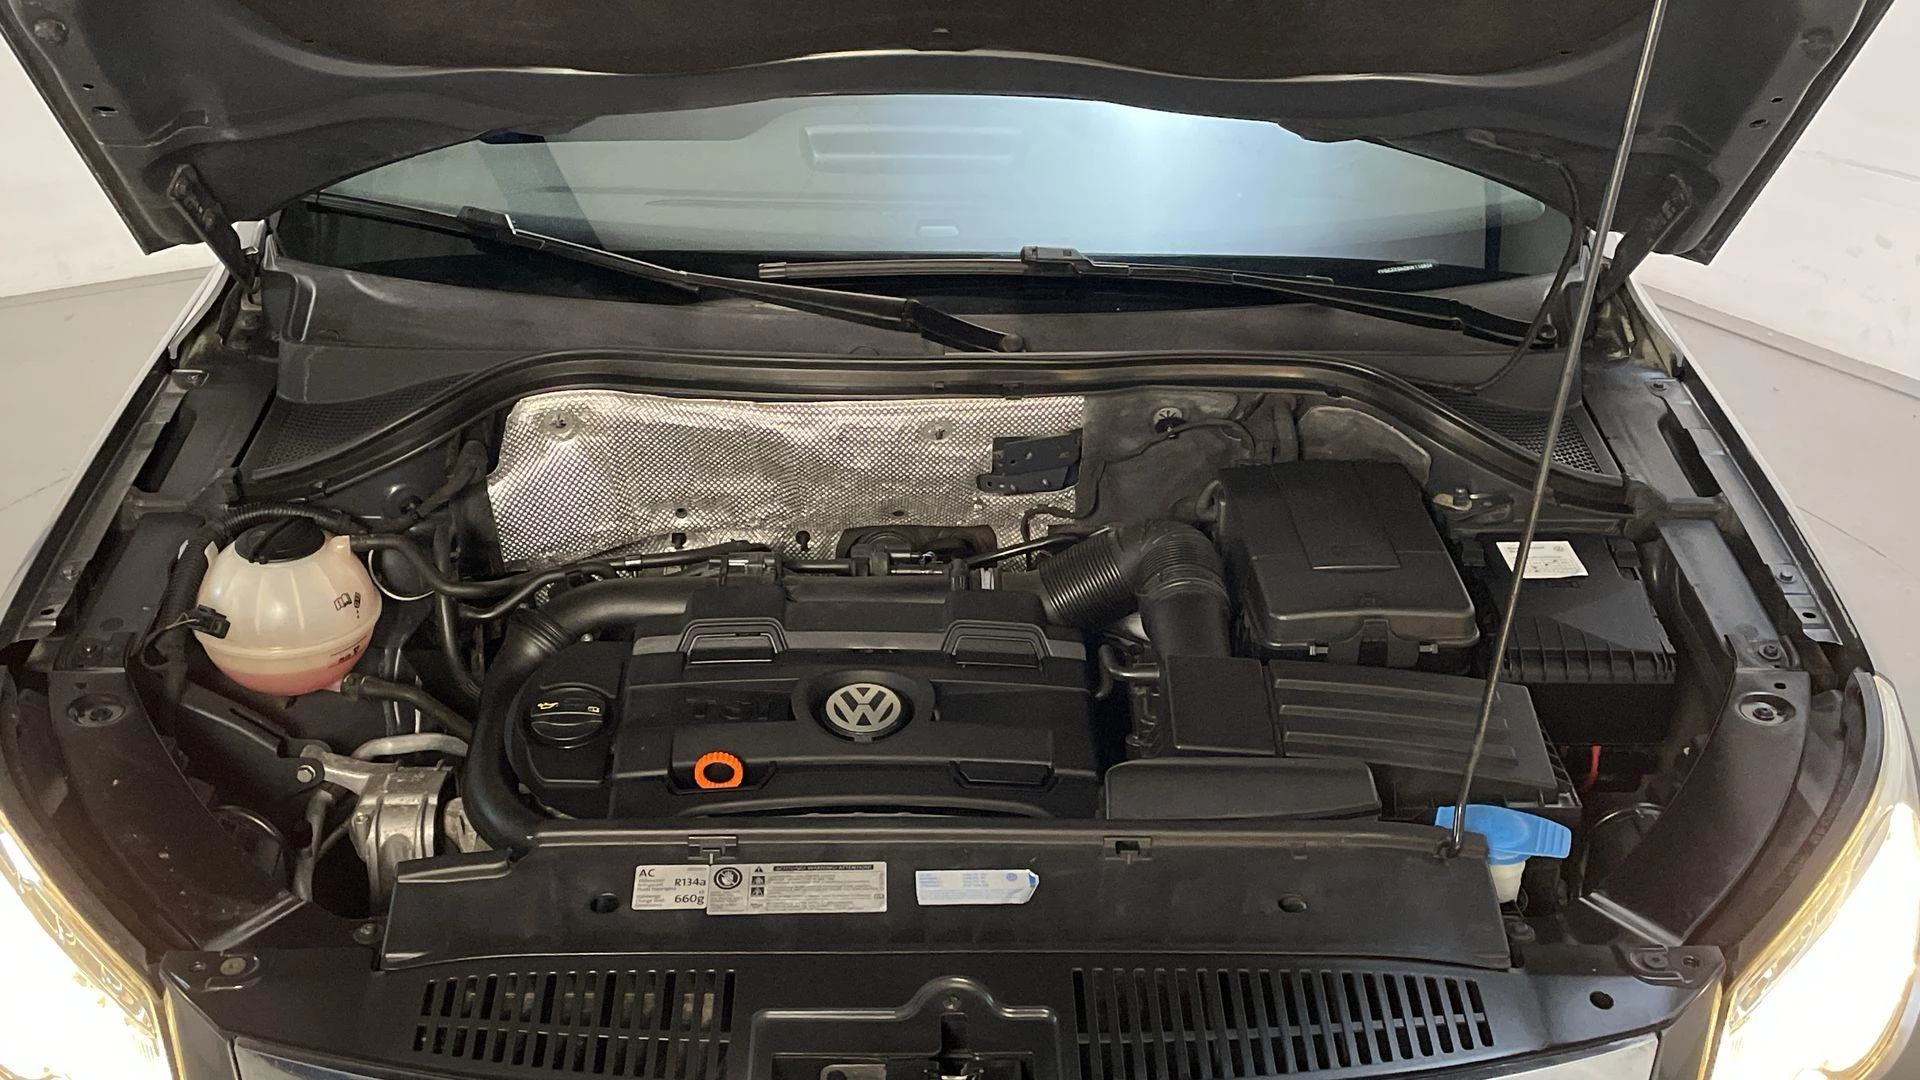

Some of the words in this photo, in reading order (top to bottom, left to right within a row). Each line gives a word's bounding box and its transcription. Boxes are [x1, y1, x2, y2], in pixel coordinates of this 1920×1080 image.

[639, 868, 655, 877] AC
[674, 878, 706, 887] R134a
[674, 894, 705, 905] 660g
